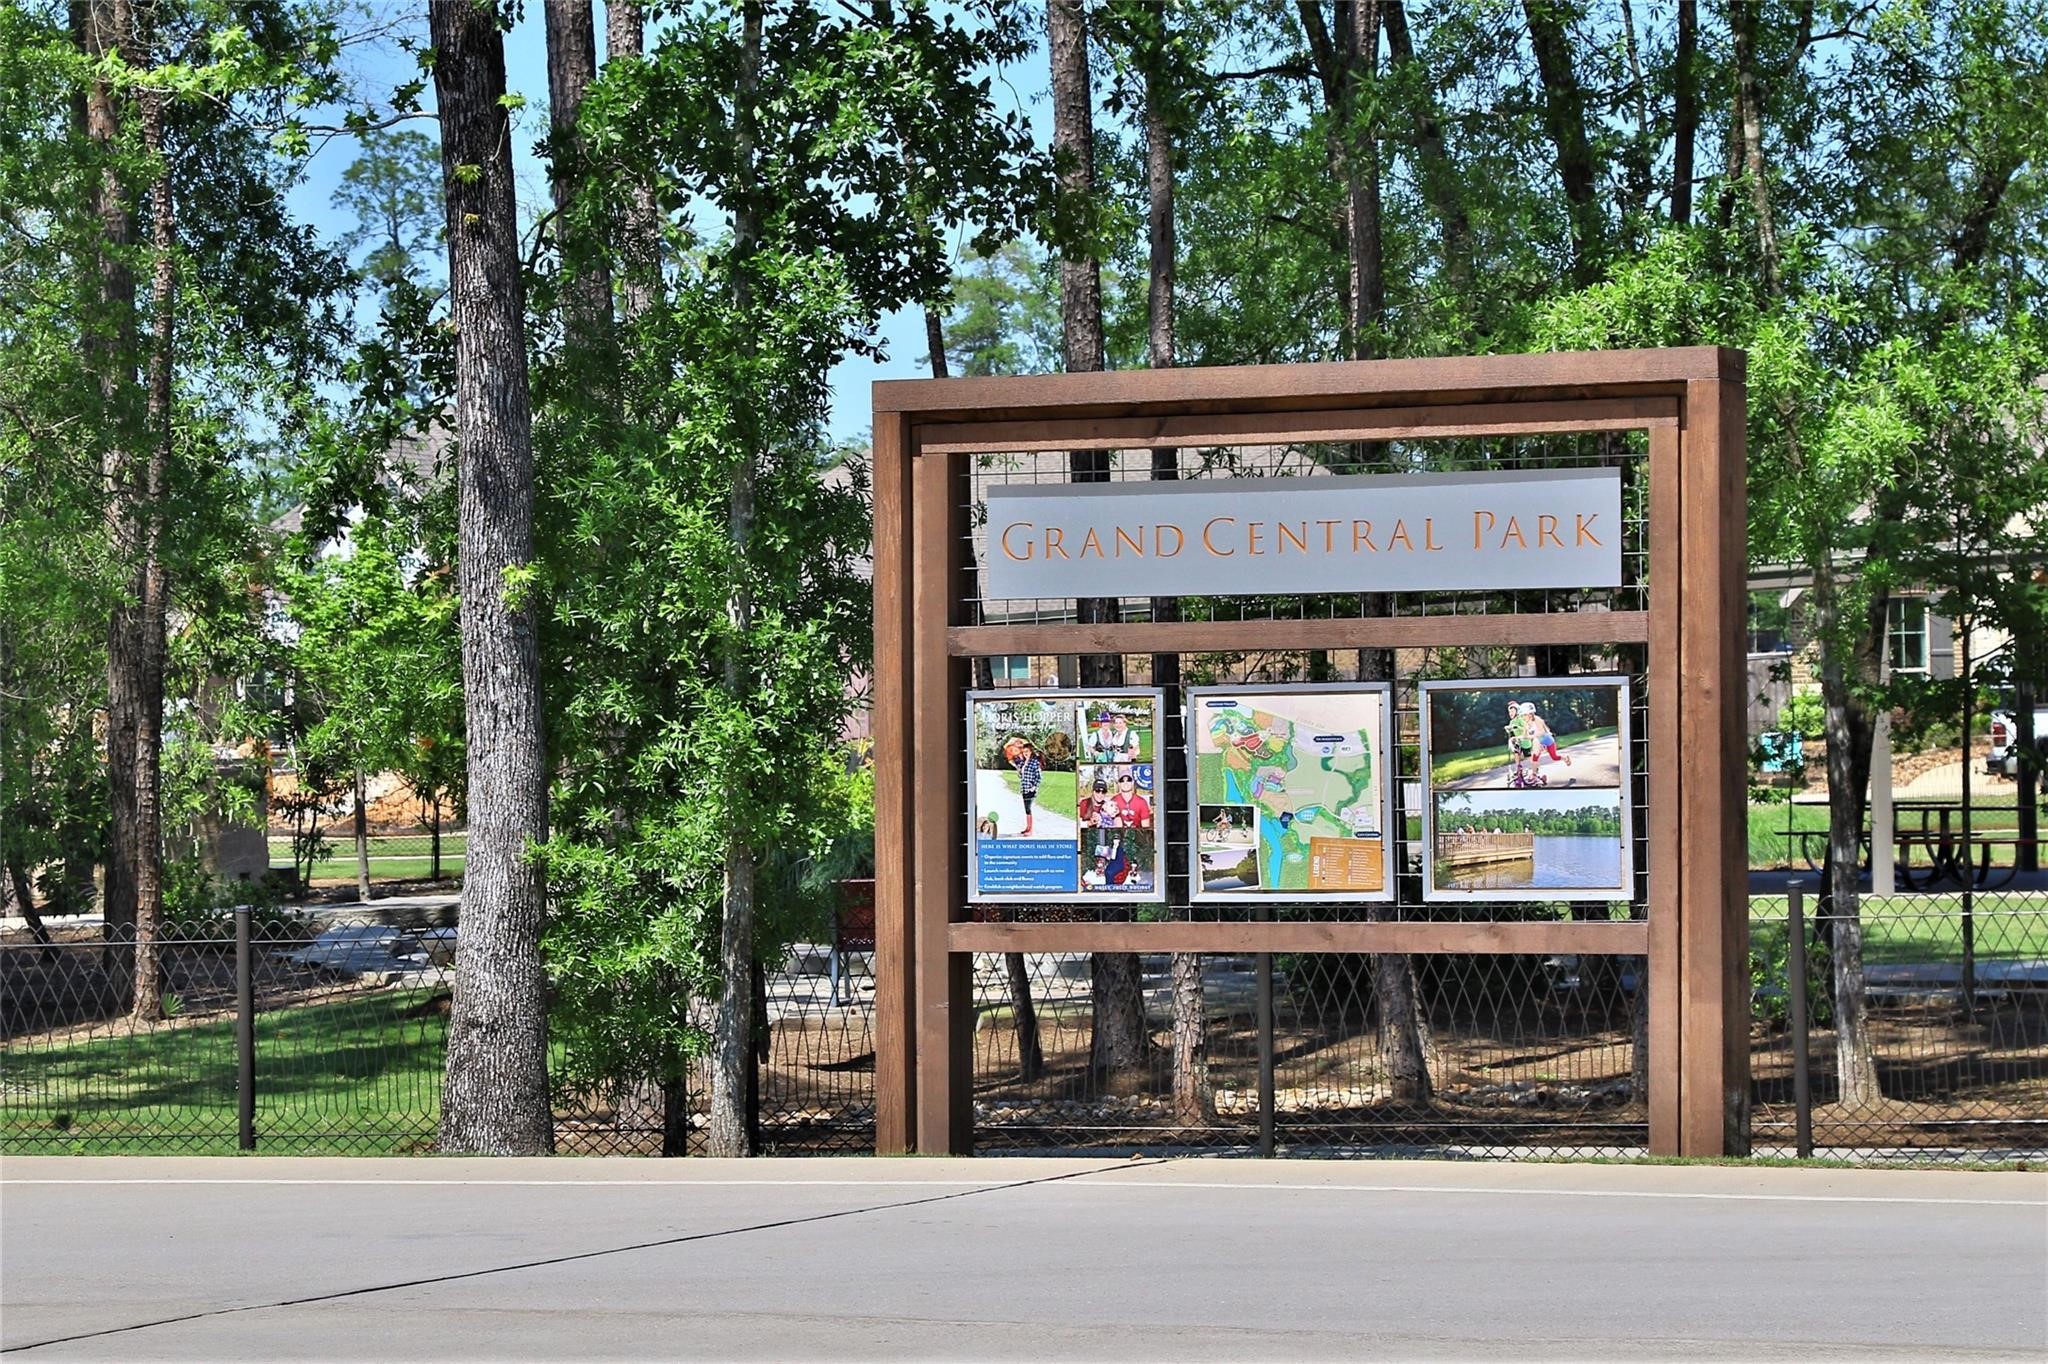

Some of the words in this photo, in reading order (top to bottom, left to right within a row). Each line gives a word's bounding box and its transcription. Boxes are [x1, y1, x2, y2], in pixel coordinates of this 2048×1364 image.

[1001, 522, 1185, 561] GRAND
[1202, 516, 1444, 557] CENTRAL
[1473, 510, 1603, 550] PARK
[1022, 711, 1072, 721] HOPPER
